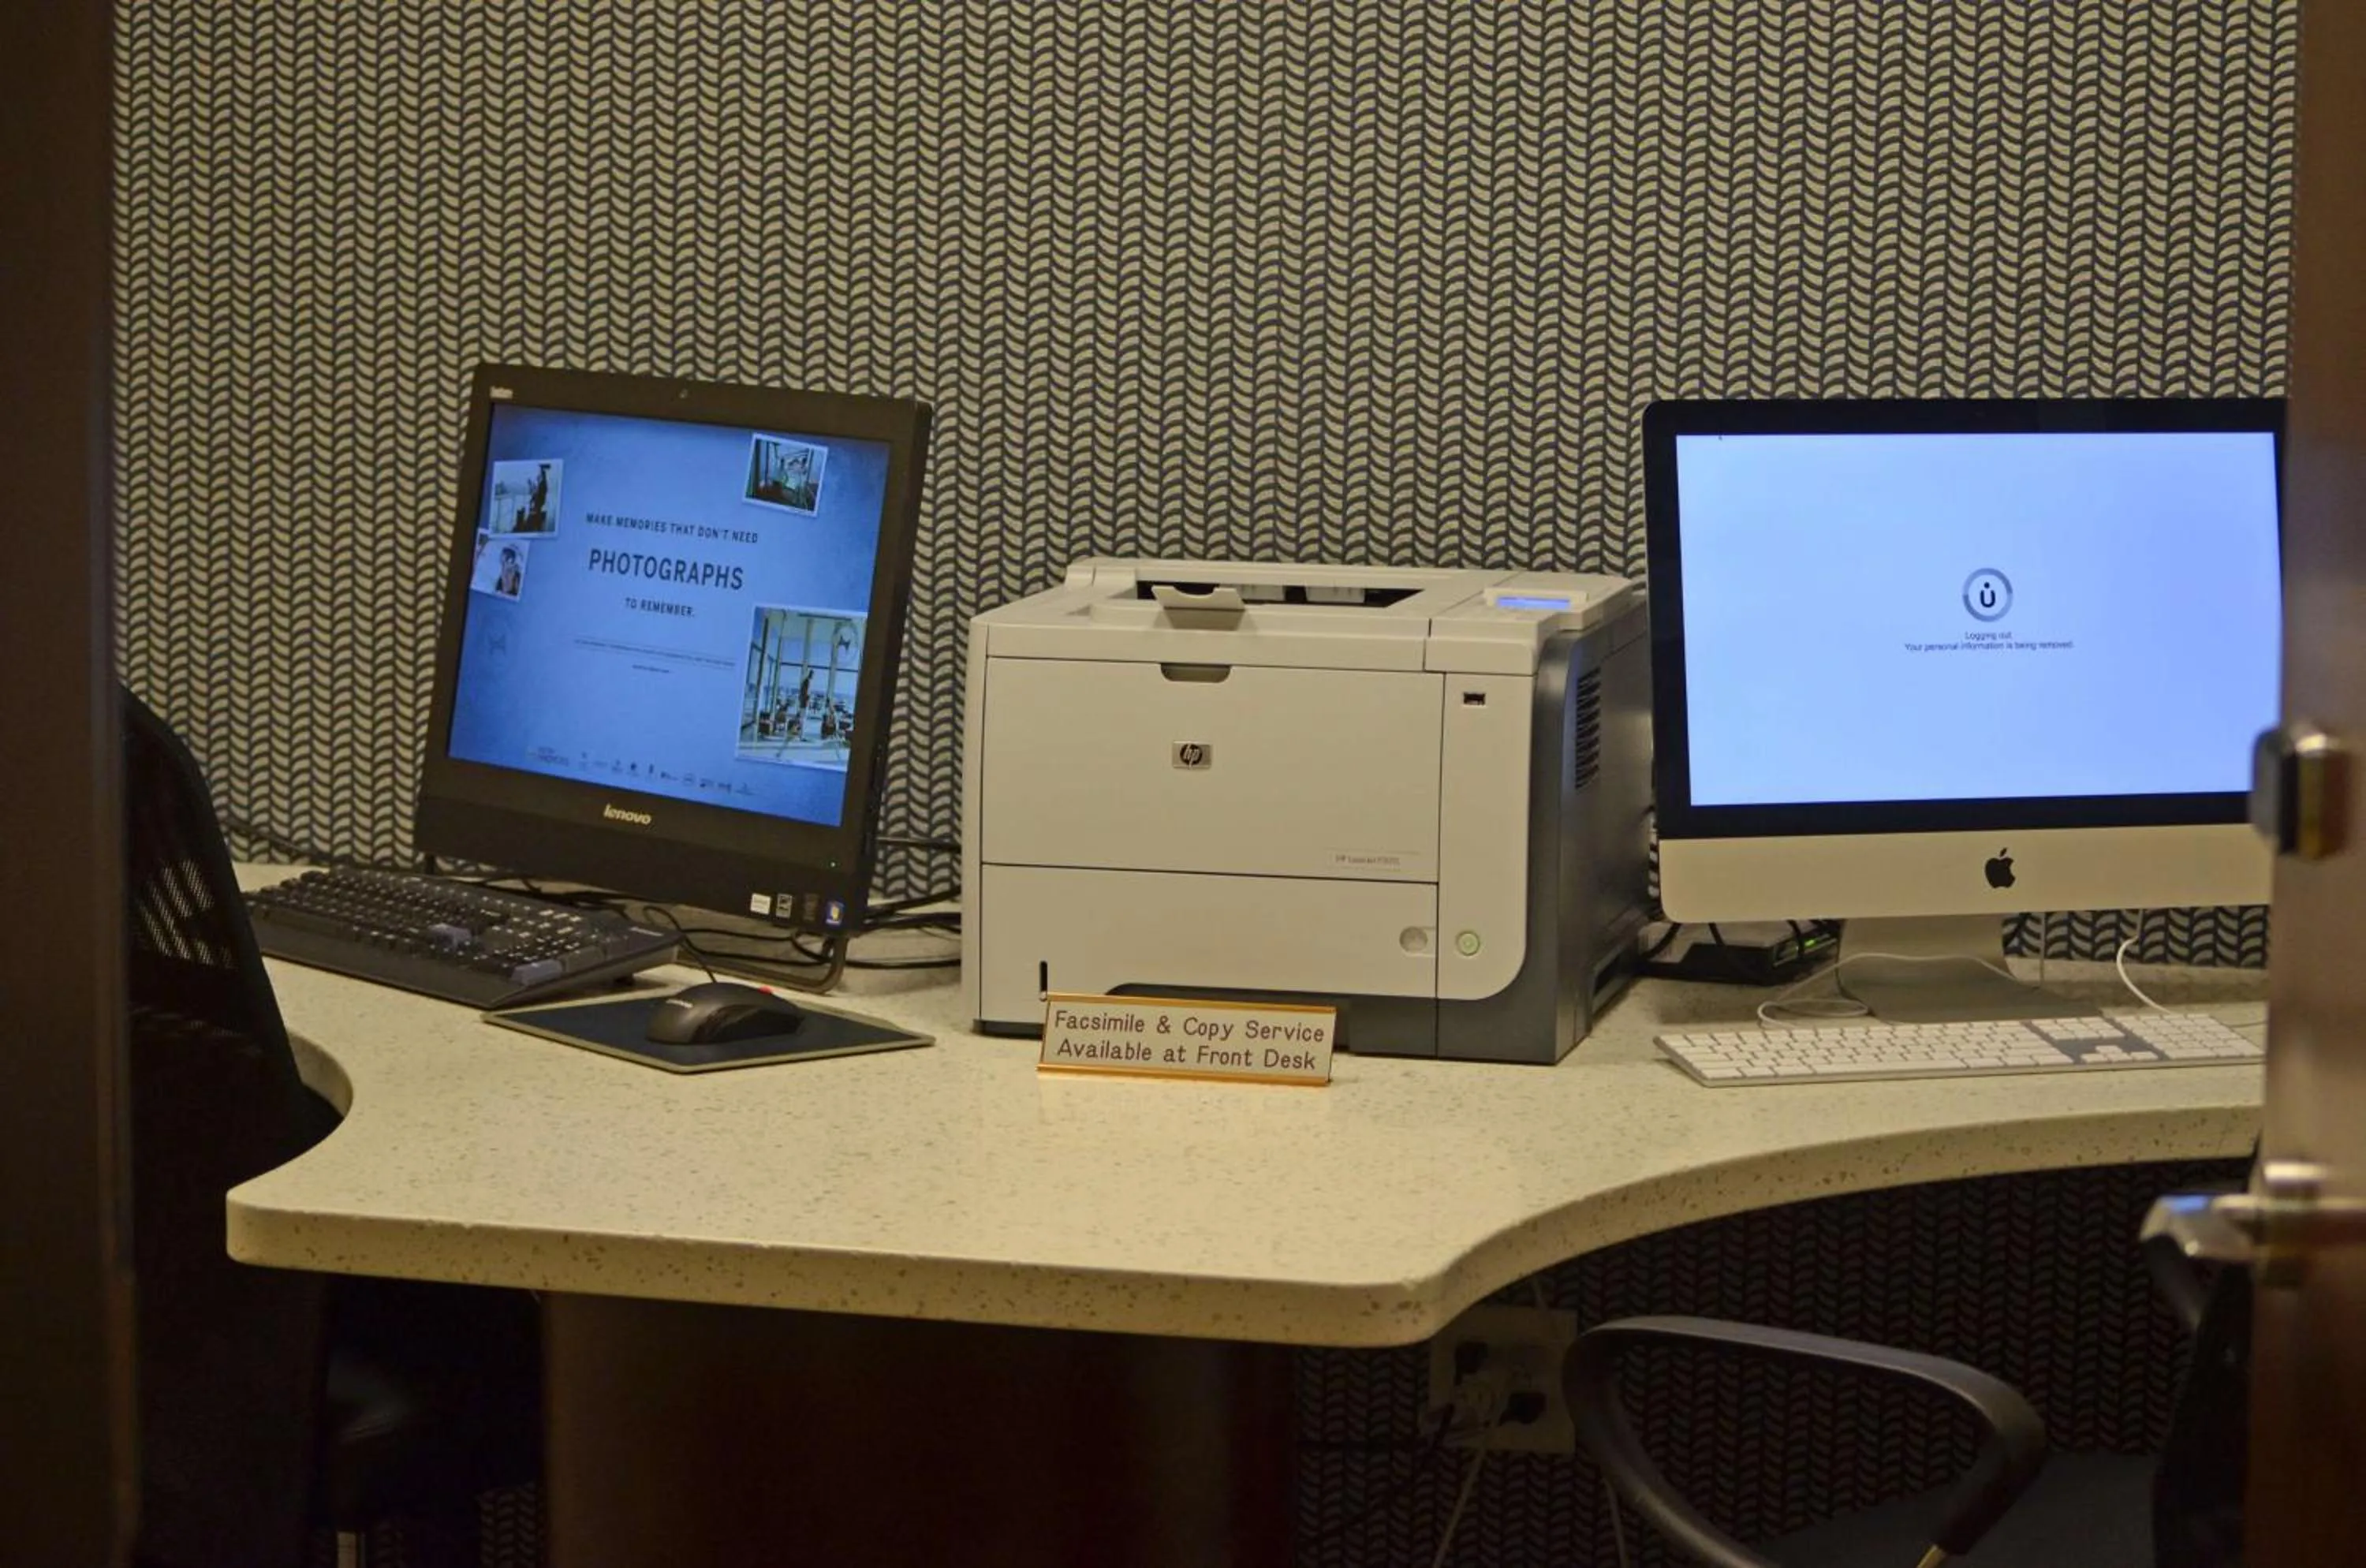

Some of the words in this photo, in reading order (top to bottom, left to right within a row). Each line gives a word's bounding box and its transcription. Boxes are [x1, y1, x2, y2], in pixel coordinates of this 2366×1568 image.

[585, 513, 612, 526] MAKE
[615, 515, 667, 533] MEMORIES
[670, 523, 695, 536] THAT
[697, 527, 728, 540] DON'T
[731, 531, 759, 544] NEED
[588, 548, 745, 591] PHOTOGRAPHS
[625, 597, 637, 610] TO
[641, 599, 695, 618] REMEMBER.
[1905, 642, 1922, 651] Your
[1924, 641, 1958, 652] personal
[1960, 639, 2004, 651] information
[2014, 640, 2037, 651] being
[603, 803, 651, 825] lenovo
[1054, 1010, 1144, 1034] Facsimile
[1157, 1015, 1171, 1034] &
[1184, 1017, 1234, 1041] Copy
[1245, 1020, 1325, 1043] Service
[1057, 1038, 1151, 1062] Available
[1163, 1047, 1186, 1063] at
[1196, 1045, 1252, 1068] Front
[1264, 1048, 1315, 1070] Desk
